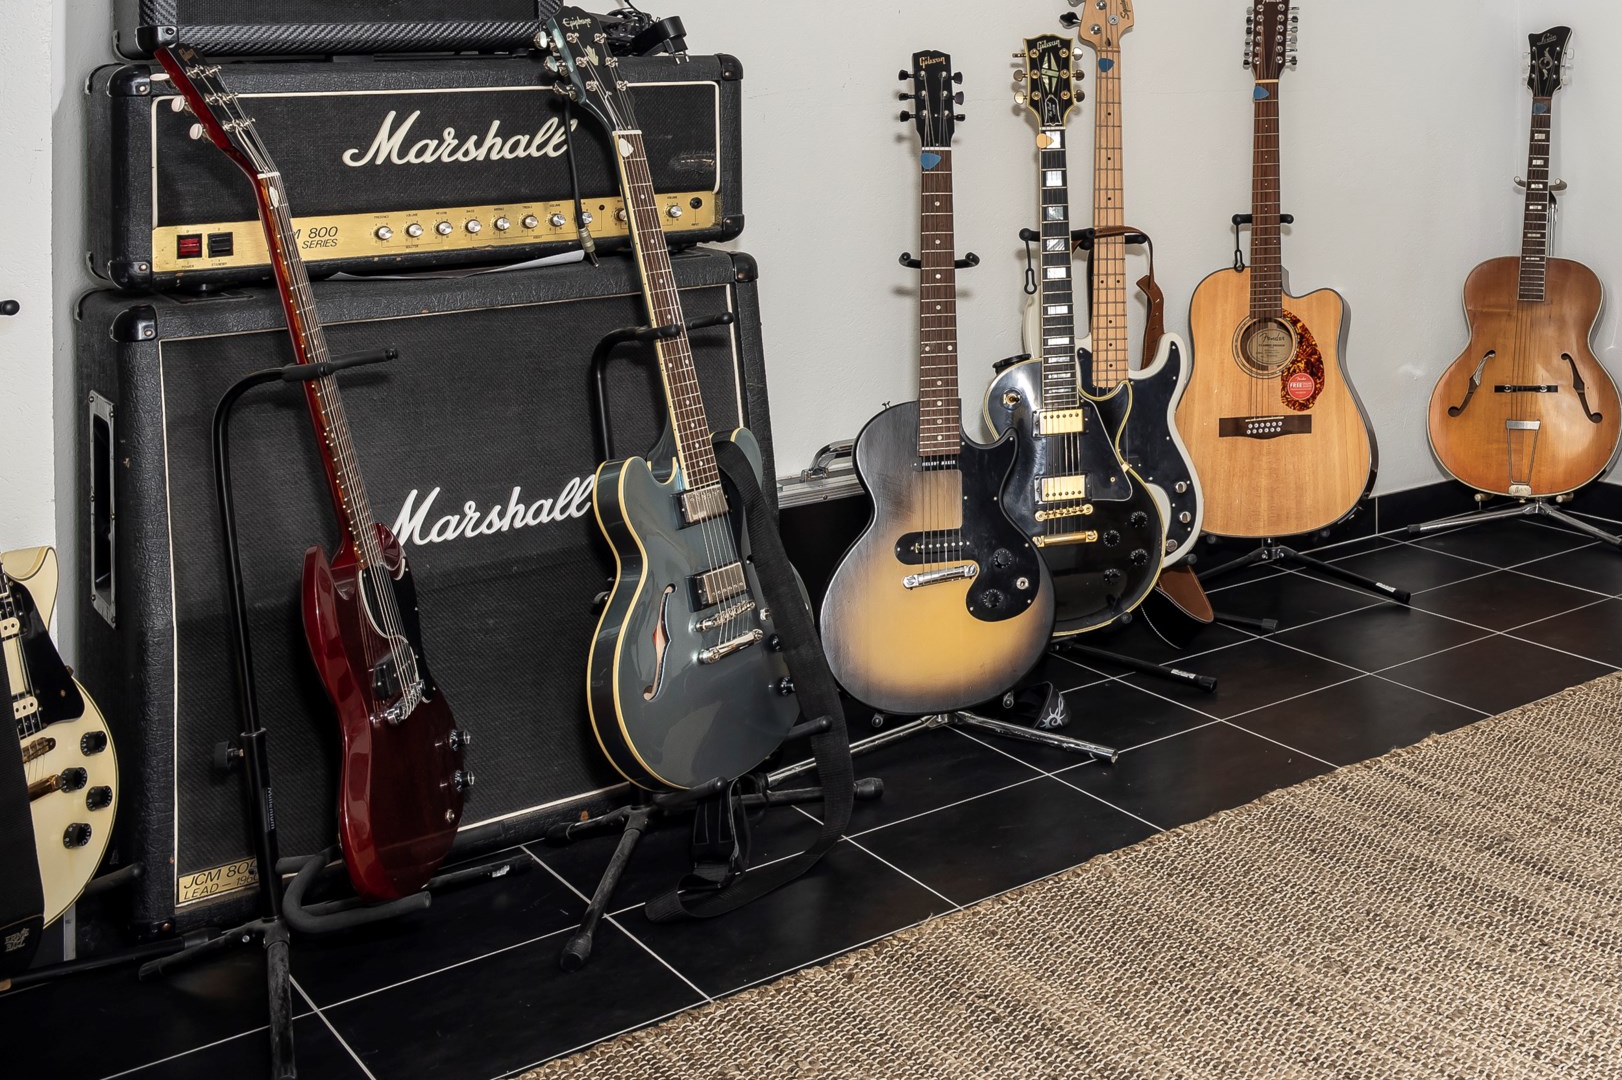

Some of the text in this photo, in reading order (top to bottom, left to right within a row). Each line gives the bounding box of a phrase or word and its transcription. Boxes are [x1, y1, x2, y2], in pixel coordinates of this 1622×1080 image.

[562, 16, 592, 30] Epiphone
[1036, 39, 1061, 50] Gibson
[920, 56, 946, 68] Gibson
[342, 110, 578, 167] Marshall
[308, 226, 338, 238] 800
[302, 238, 337, 249] SERIES
[392, 474, 596, 546] Marshall
[184, 869, 222, 889] JCM
